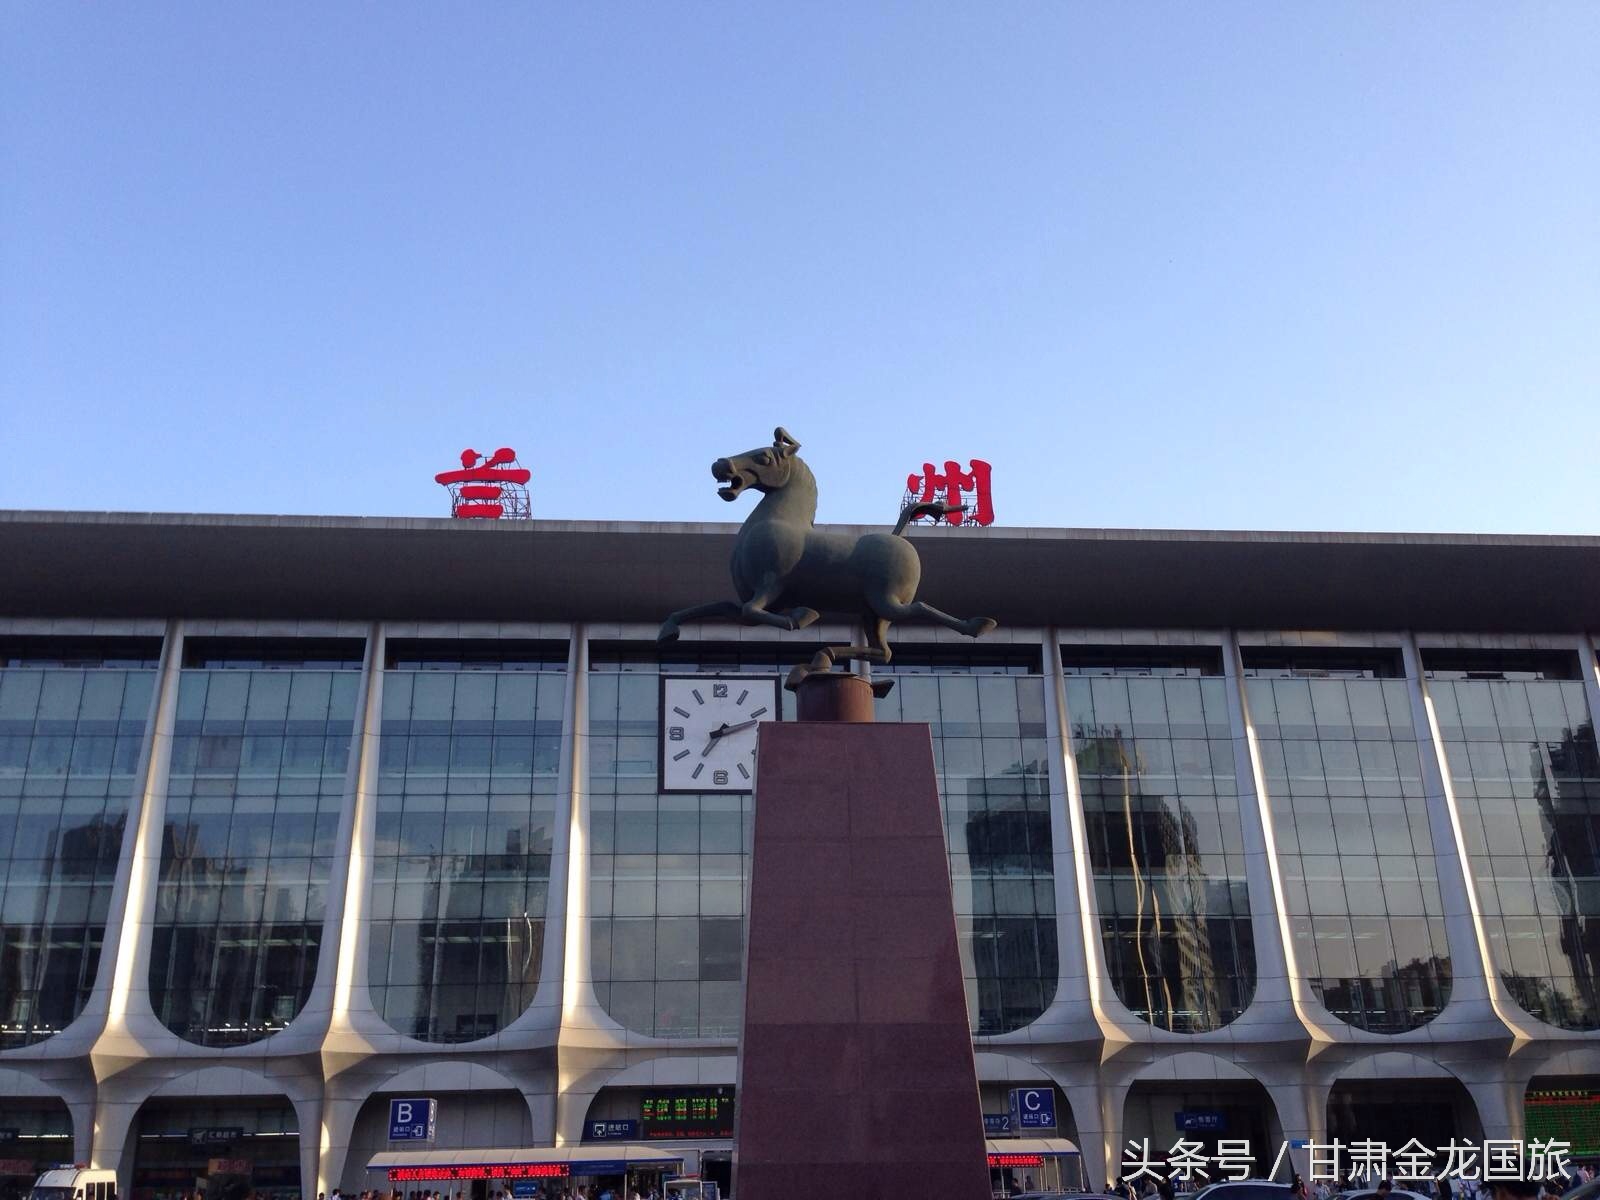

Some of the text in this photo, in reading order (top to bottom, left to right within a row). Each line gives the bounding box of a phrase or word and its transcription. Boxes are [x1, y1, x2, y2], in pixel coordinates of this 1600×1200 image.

[435, 447, 994, 527] 兰 州
[713, 684, 728, 698] 12
[669, 726, 685, 741] 9
[713, 770, 729, 785] 6
[1025, 1091, 1041, 1111] C
[397, 1103, 413, 1123] B
[1001, 1116, 1009, 1130] 2
